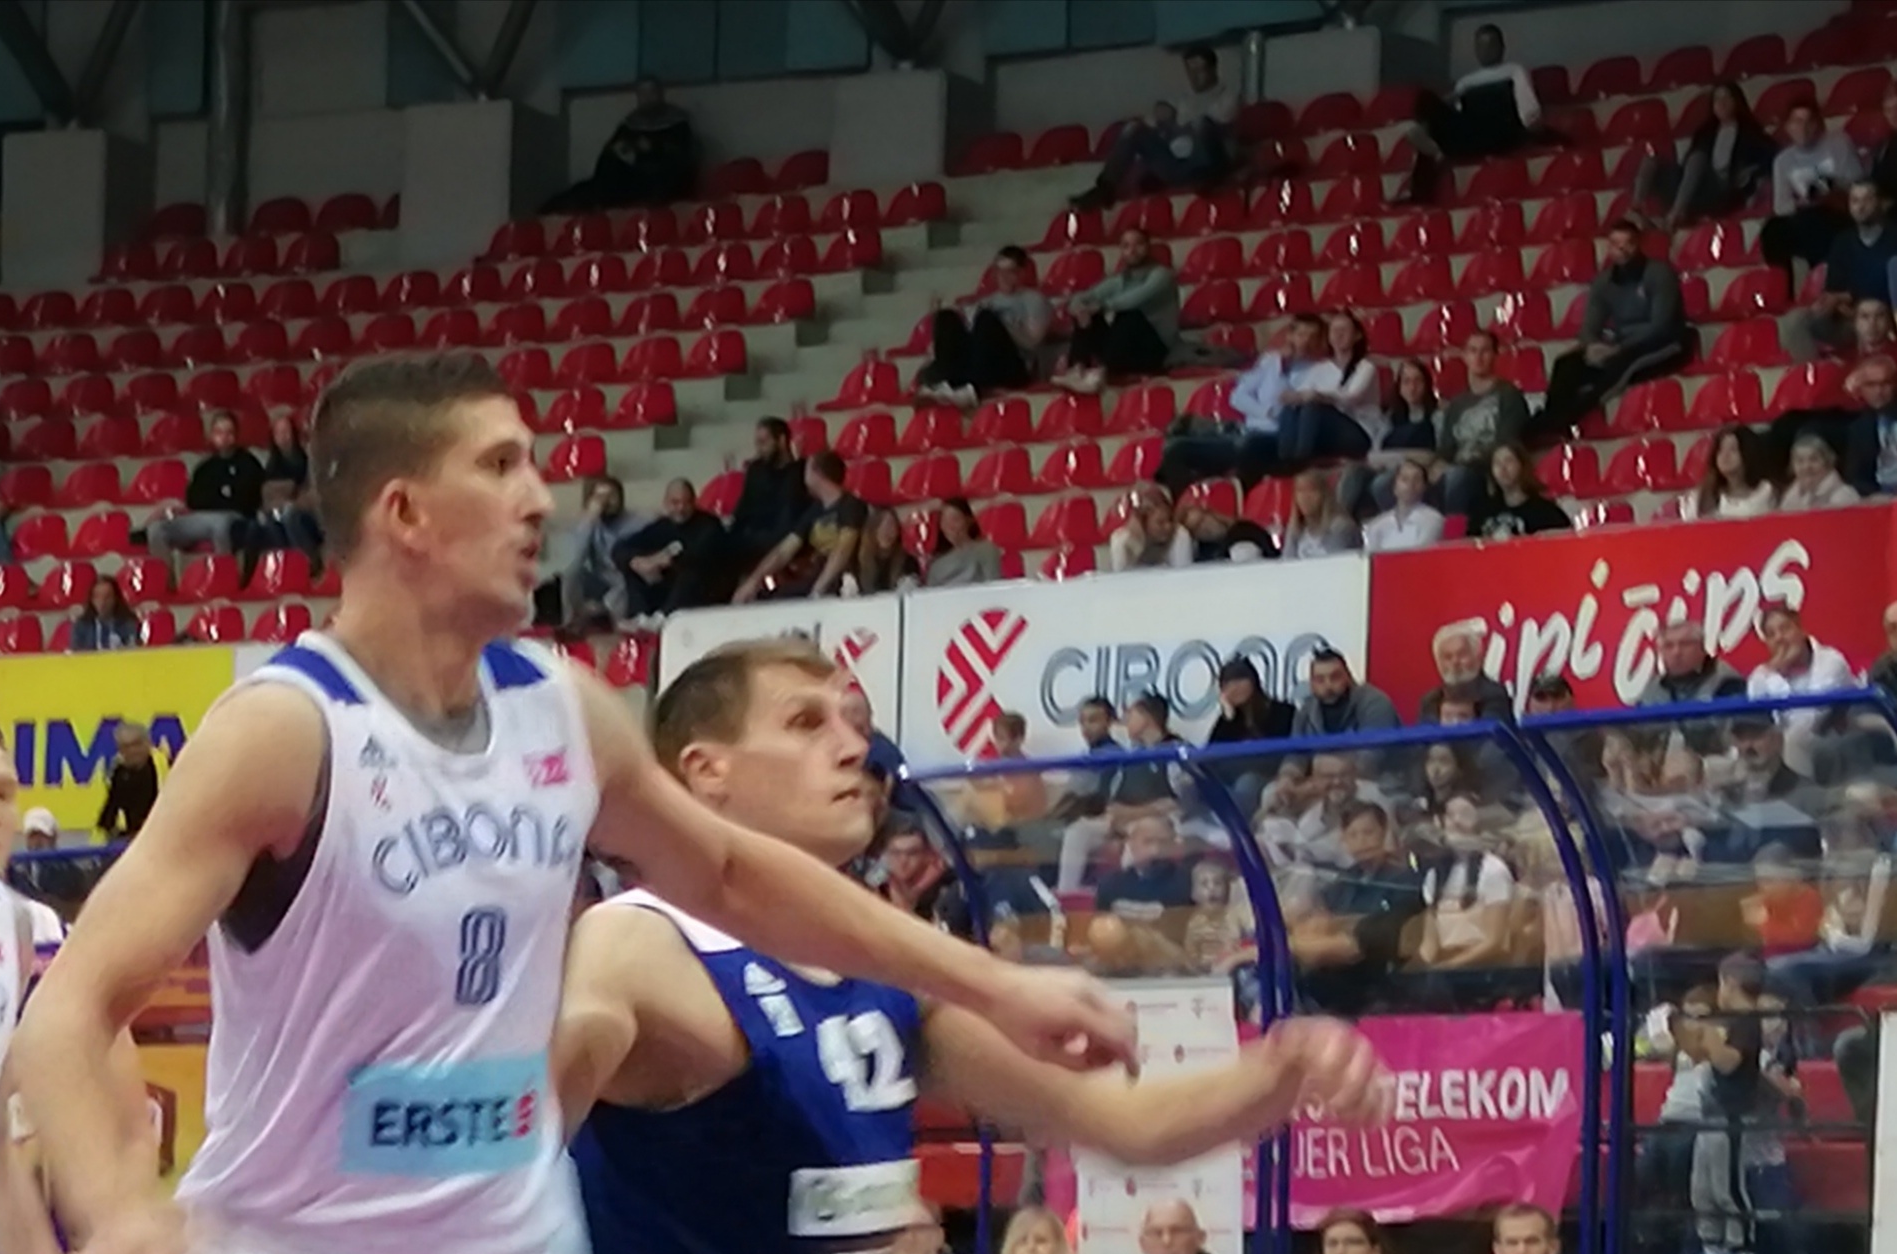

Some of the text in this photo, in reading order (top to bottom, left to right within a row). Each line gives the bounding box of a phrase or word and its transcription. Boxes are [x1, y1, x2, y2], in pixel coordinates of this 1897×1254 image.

[14, 713, 189, 786] IMA
[454, 906, 507, 1006] 8
[371, 1096, 511, 1148] ERSTE
[1358, 1123, 1460, 1177] LIGA
